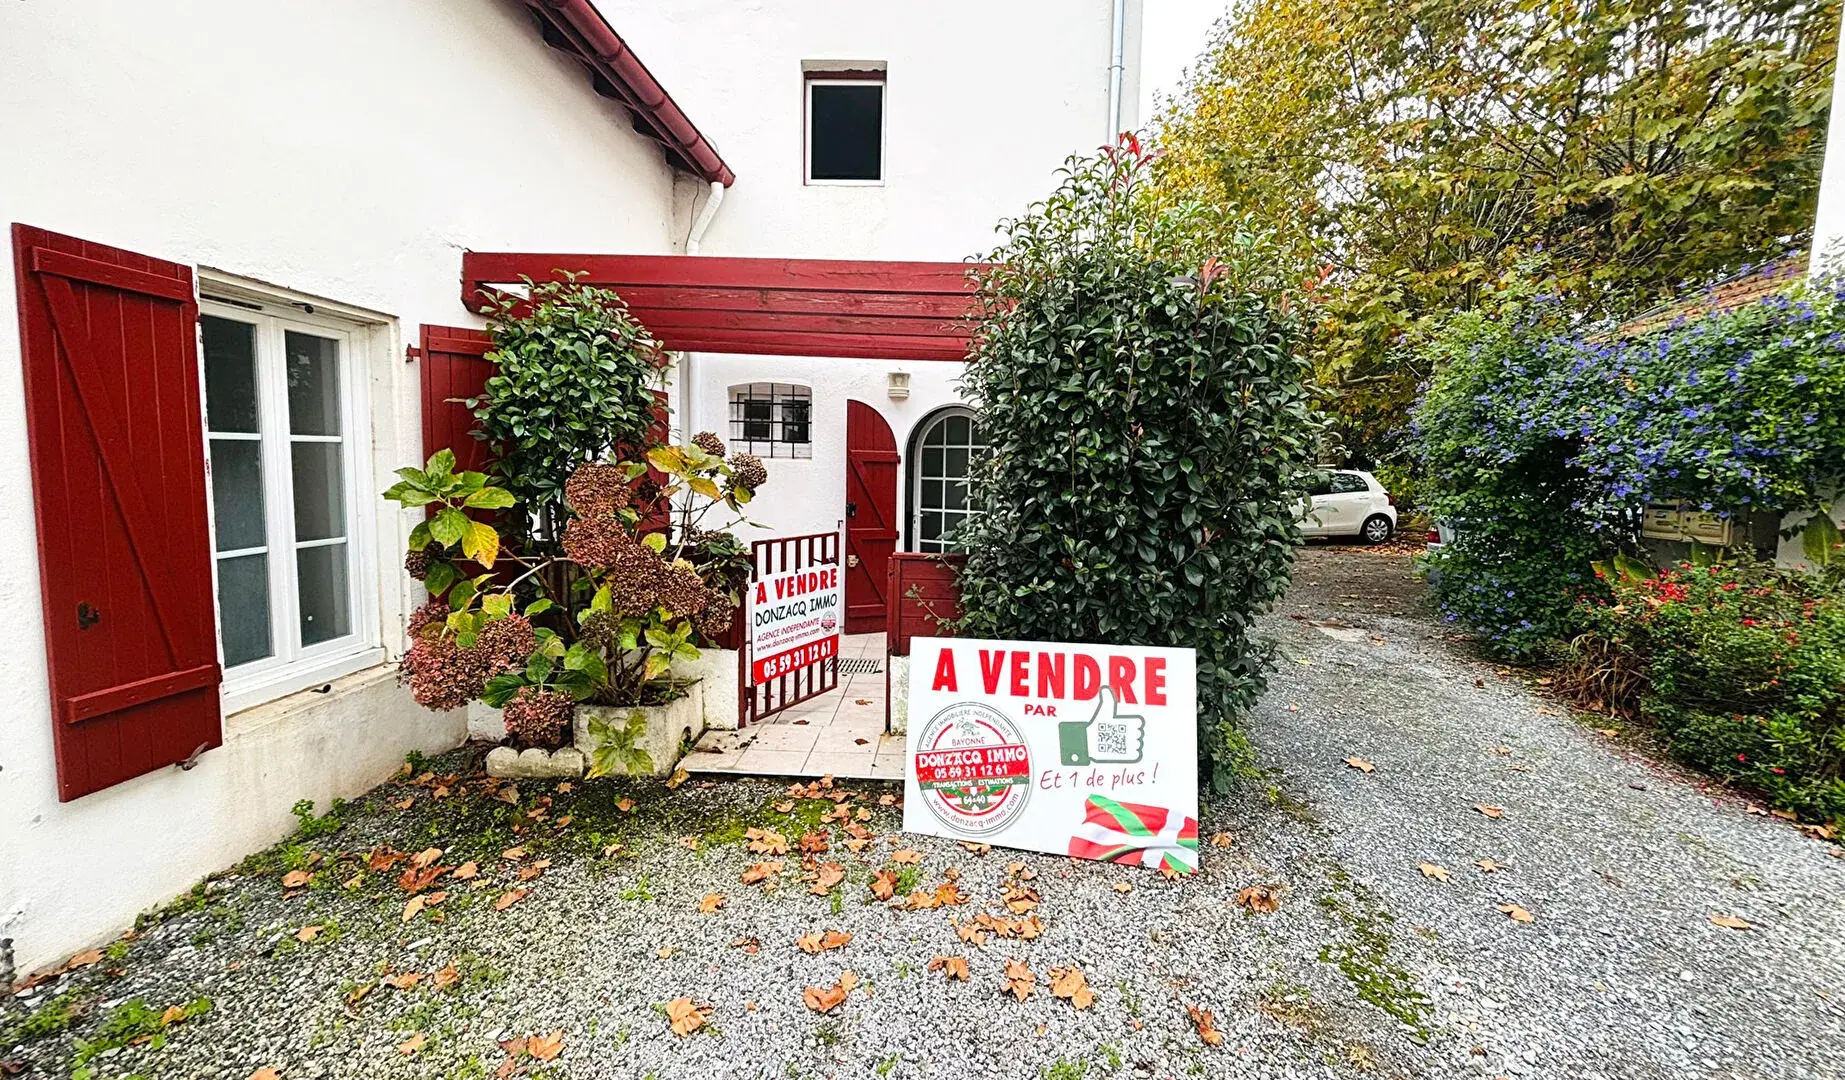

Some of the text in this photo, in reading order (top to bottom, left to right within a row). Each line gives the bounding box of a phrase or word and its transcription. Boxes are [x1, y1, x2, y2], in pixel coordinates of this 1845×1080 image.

[756, 568, 837, 605] A VENDRE
[755, 601, 806, 627] DONZACQ
[810, 593, 837, 612] IMMO
[757, 628, 780, 643] AGENCE
[764, 640, 831, 678] 05 59 31 12 61
[932, 647, 1167, 706] A VENDRE
[1024, 704, 1057, 717] PAR
[925, 727, 940, 748] AGENCE
[952, 737, 985, 747] BAYONNE
[918, 747, 1026, 768] DONZACQ IMMO
[934, 767, 947, 779] 05
[964, 765, 977, 777] 31
[980, 764, 993, 776] 12
[995, 763, 1008, 775] 61
[1040, 762, 1159, 791] Et 1 de plus !
[932, 777, 1014, 789] TRANSACTIONS ESTIMATIONS
